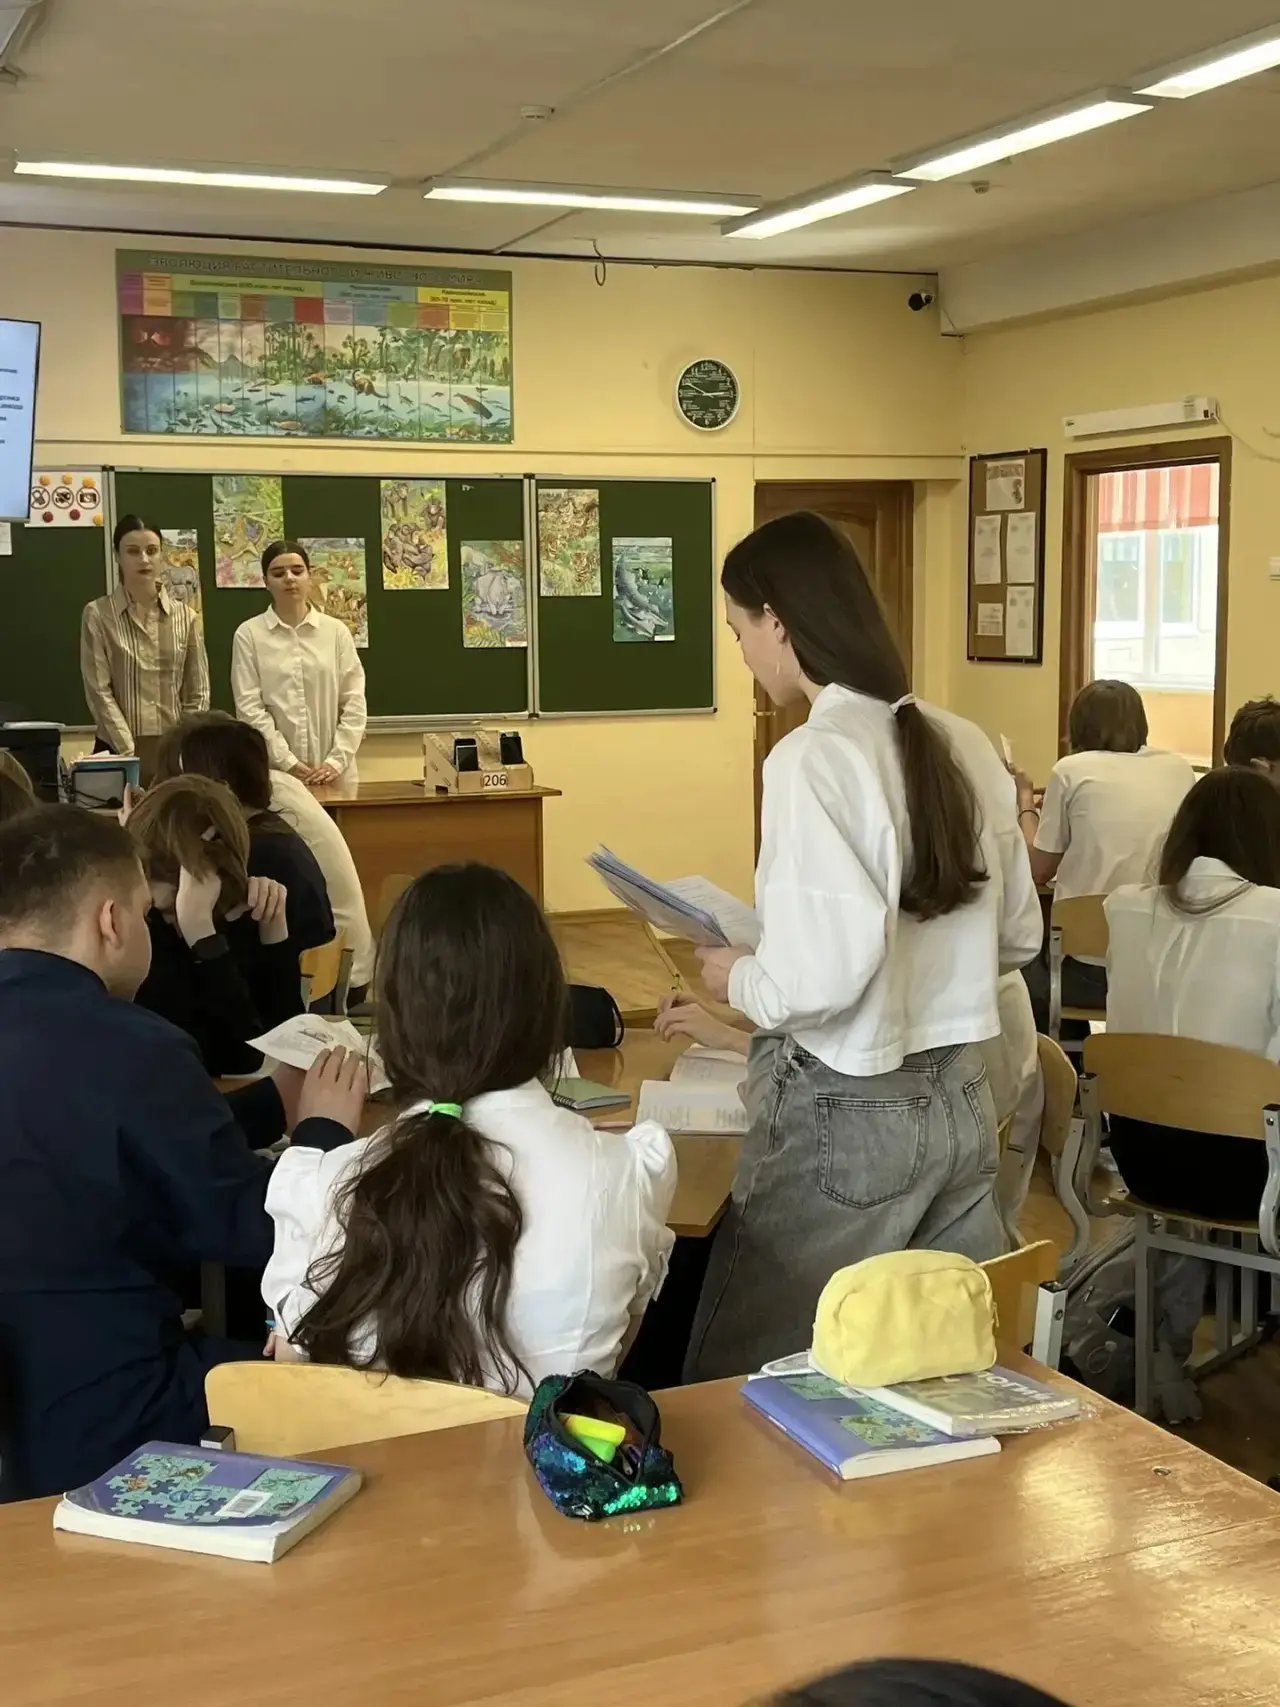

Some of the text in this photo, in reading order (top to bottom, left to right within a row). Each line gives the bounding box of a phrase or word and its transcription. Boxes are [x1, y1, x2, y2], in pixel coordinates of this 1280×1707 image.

[234, 260, 347, 278] РАСИТЕЛЬНОГ
[363, 270, 444, 284] ЖИВОНО
[484, 774, 507, 786] 206
